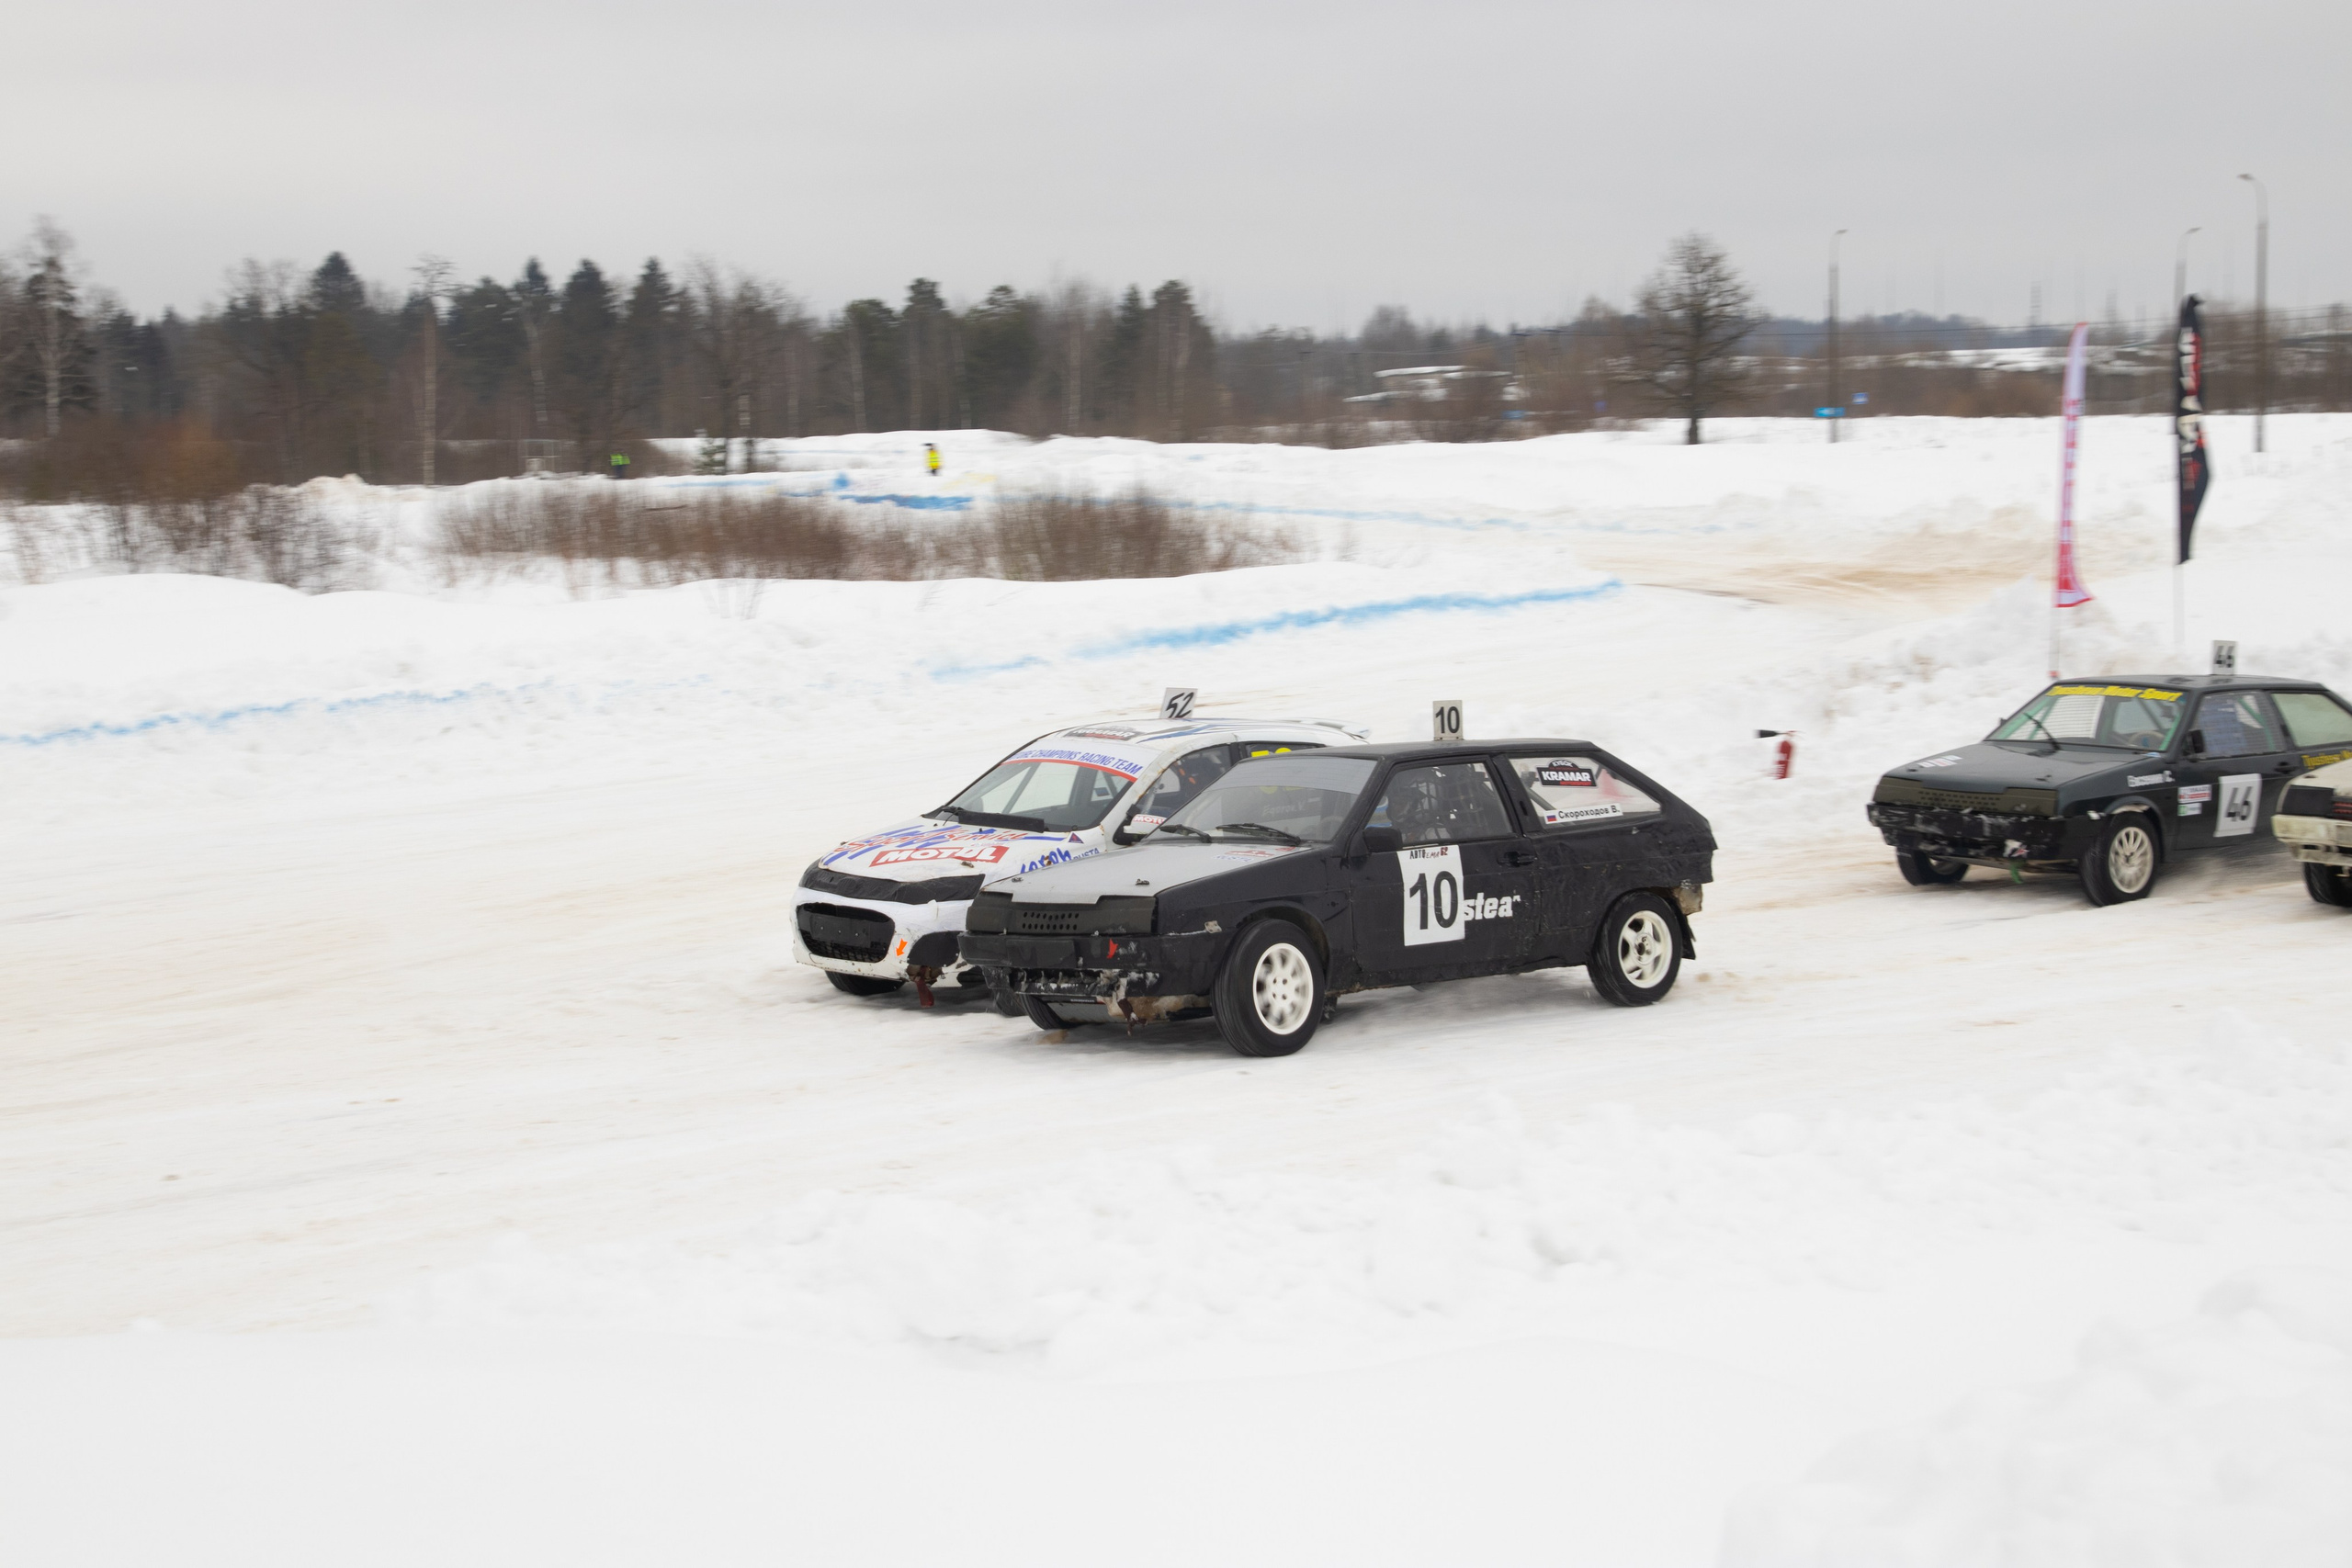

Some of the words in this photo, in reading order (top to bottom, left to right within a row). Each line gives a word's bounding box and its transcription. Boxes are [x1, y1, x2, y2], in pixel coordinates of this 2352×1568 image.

[1165, 692, 1194, 718] 52
[1435, 705, 1460, 734] 10
[1077, 751, 1115, 766] RACING
[1111, 758, 1144, 775] TEAM
[1541, 771, 1592, 782] KRAMAR
[1557, 807, 1610, 819] Скороходов
[2225, 785, 2254, 822] 46
[876, 846, 998, 863] MOTUL
[1409, 870, 1459, 931] 10
